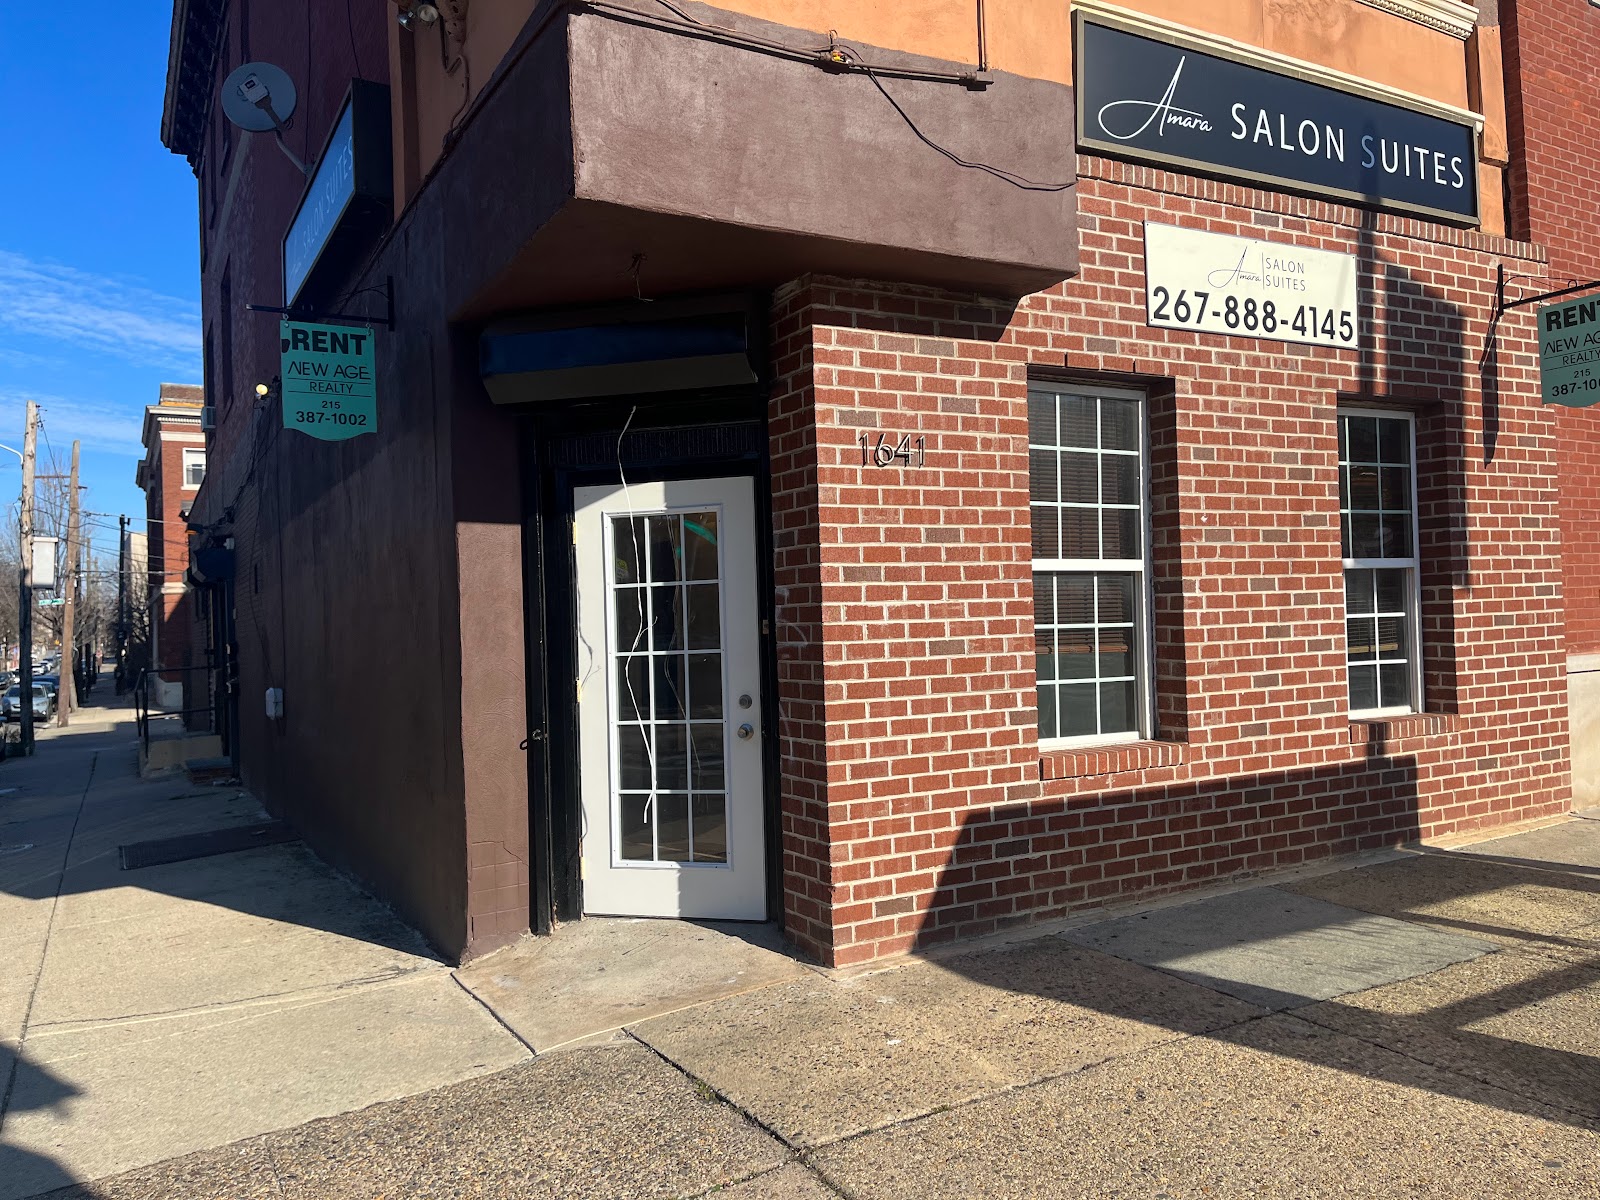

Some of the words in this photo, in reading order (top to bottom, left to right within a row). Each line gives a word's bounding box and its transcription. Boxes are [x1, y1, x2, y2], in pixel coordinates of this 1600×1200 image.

[1097, 55, 1213, 140] Amara
[1230, 102, 1345, 163] SALON
[1361, 134, 1465, 189] SUITES
[303, 195, 325, 259] SALON
[326, 135, 354, 214] SUITES
[1207, 245, 1261, 289] Amara
[1265, 257, 1305, 274] SALON
[1265, 274, 1306, 291] SUITES
[1152, 285, 1354, 342] 267-888-4145
[1545, 300, 1600, 332] REN
[291, 328, 367, 356] RENT
[1544, 335, 1579, 355] NEW
[1583, 330, 1600, 347] AG
[287, 360, 329, 377] NEW
[333, 364, 371, 380] AGE
[1573, 368, 1591, 378] 215
[309, 381, 354, 394] REALTY
[1552, 378, 1600, 397] 387-10
[321, 400, 341, 410] 215
[295, 411, 367, 426] 387-1002
[858, 432, 926, 468] 1641
